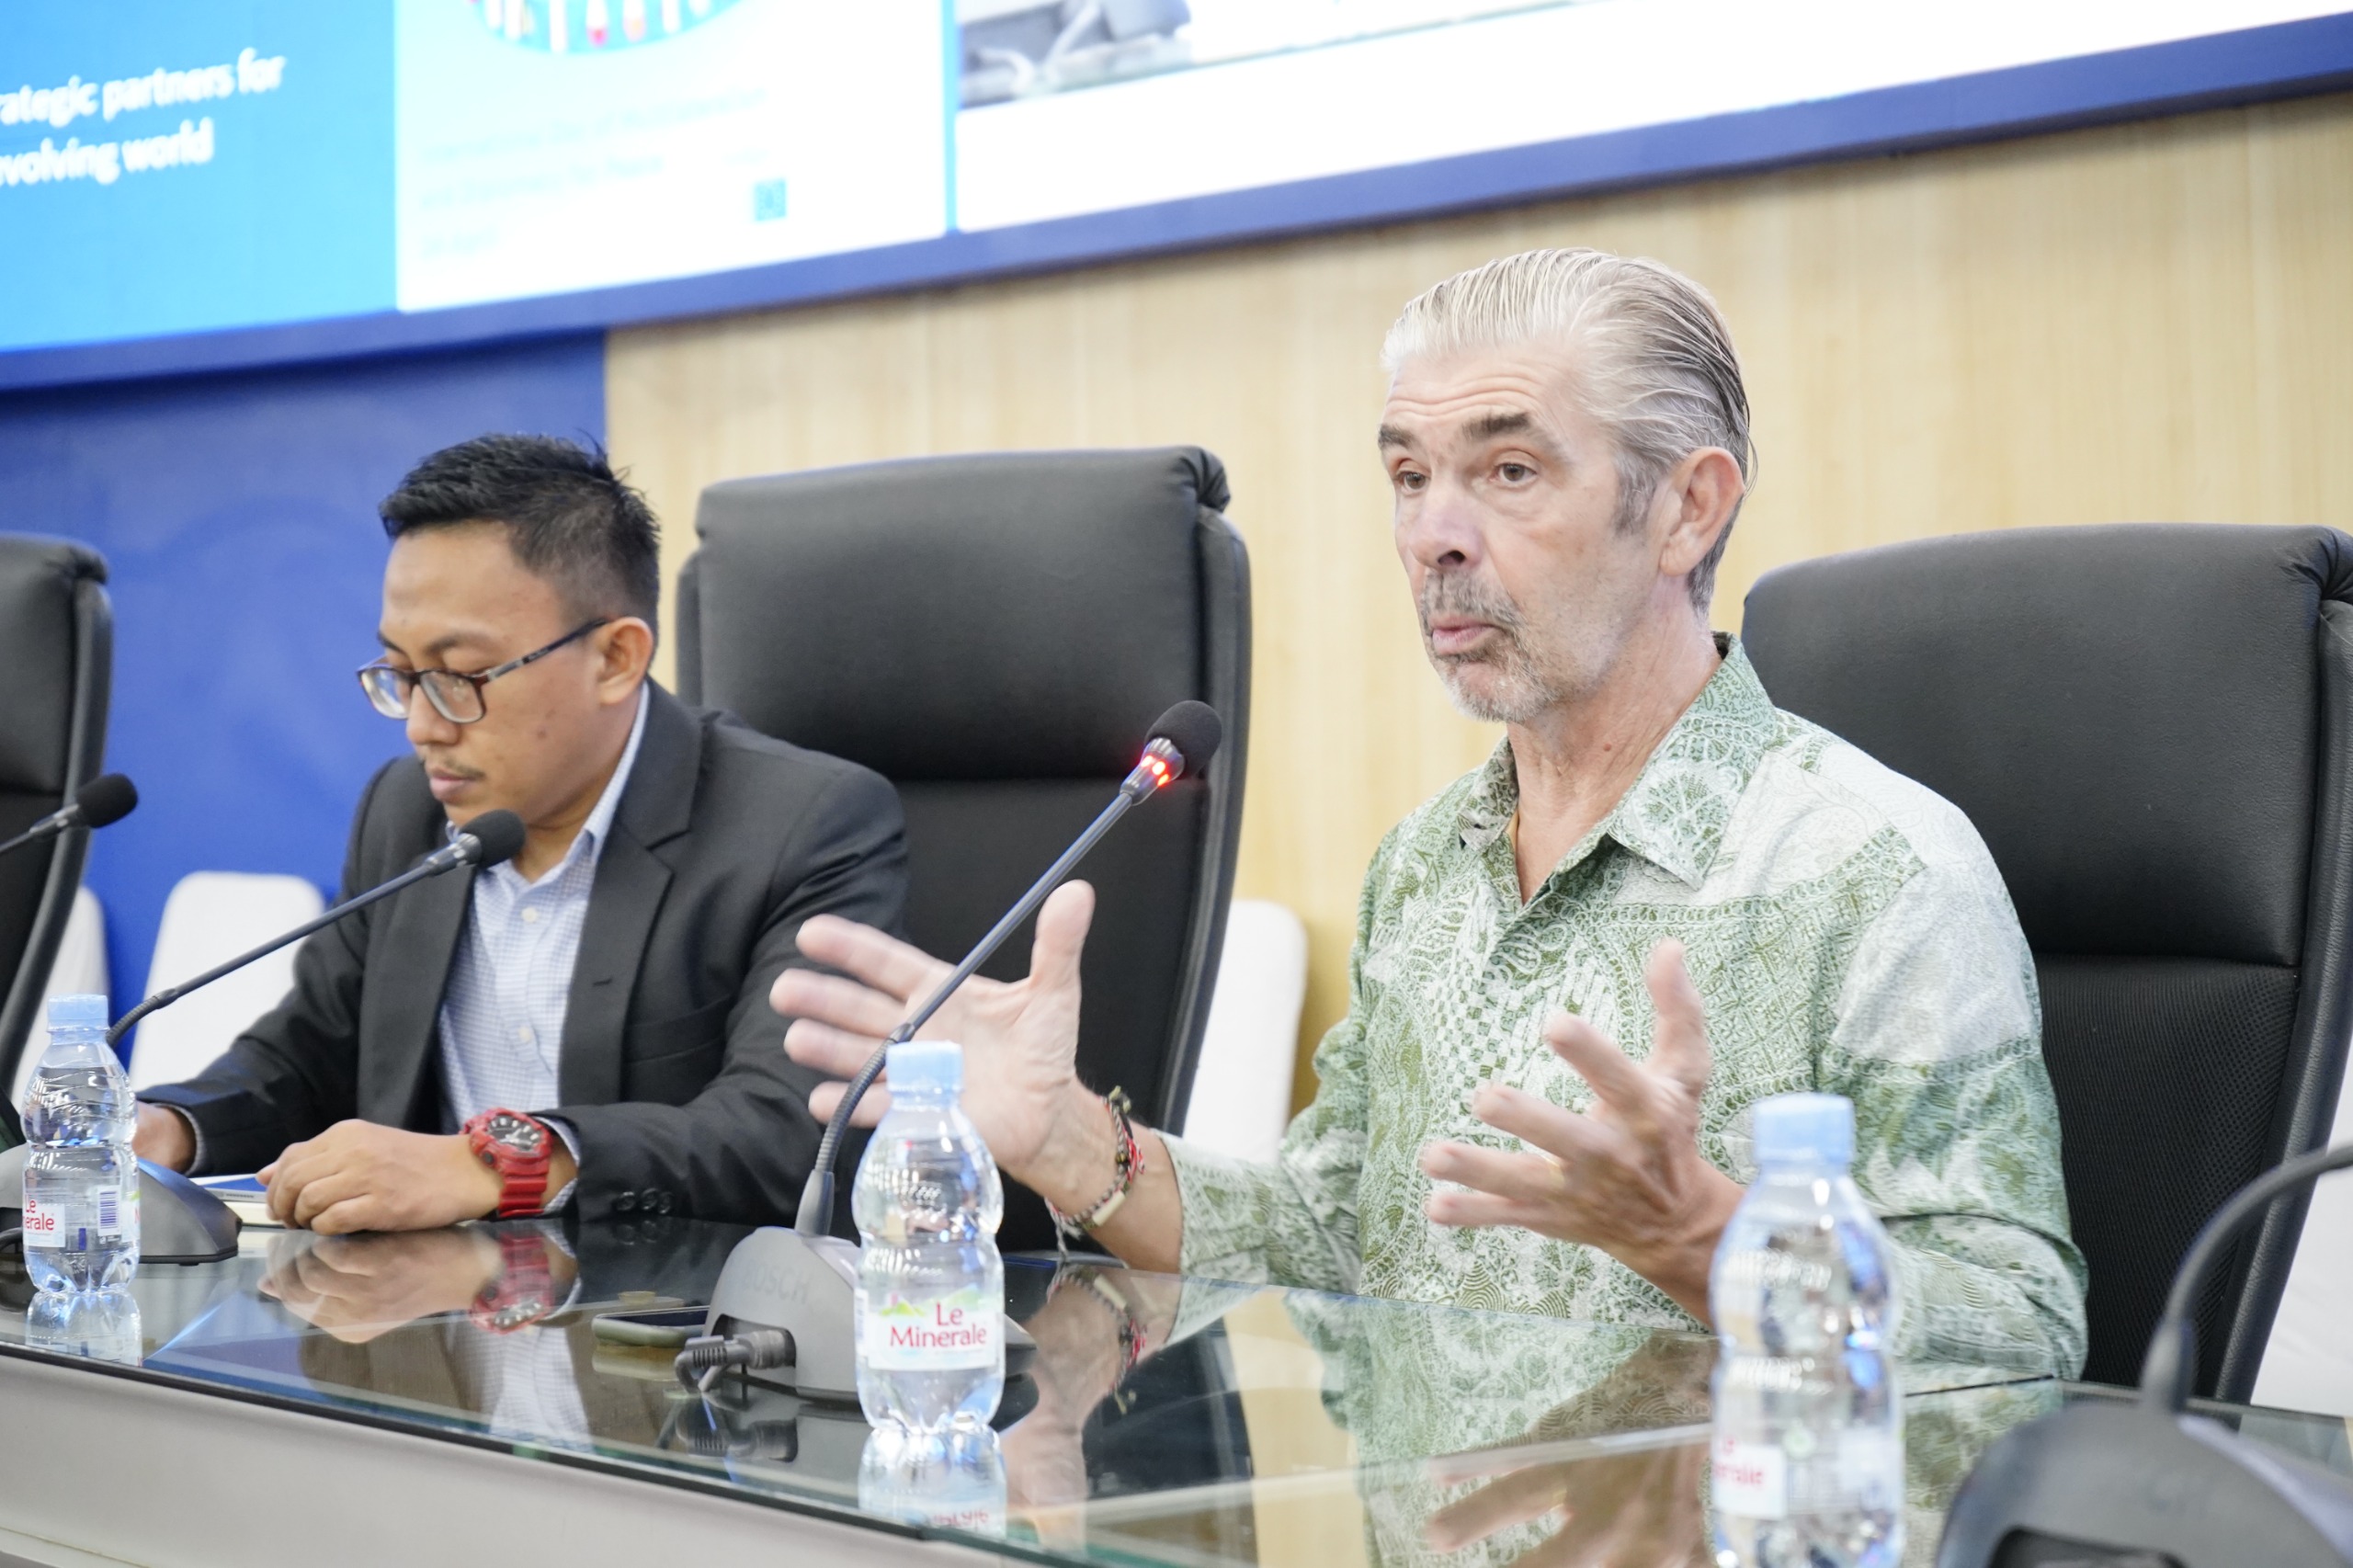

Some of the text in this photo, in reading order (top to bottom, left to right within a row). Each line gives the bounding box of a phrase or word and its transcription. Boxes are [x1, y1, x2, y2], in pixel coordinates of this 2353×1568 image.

[102, 67, 234, 121] partners
[237, 47, 287, 94] for
[0, 117, 214, 186] volving world
[890, 1324, 987, 1347] Minerale
[936, 1301, 963, 1326] Le
